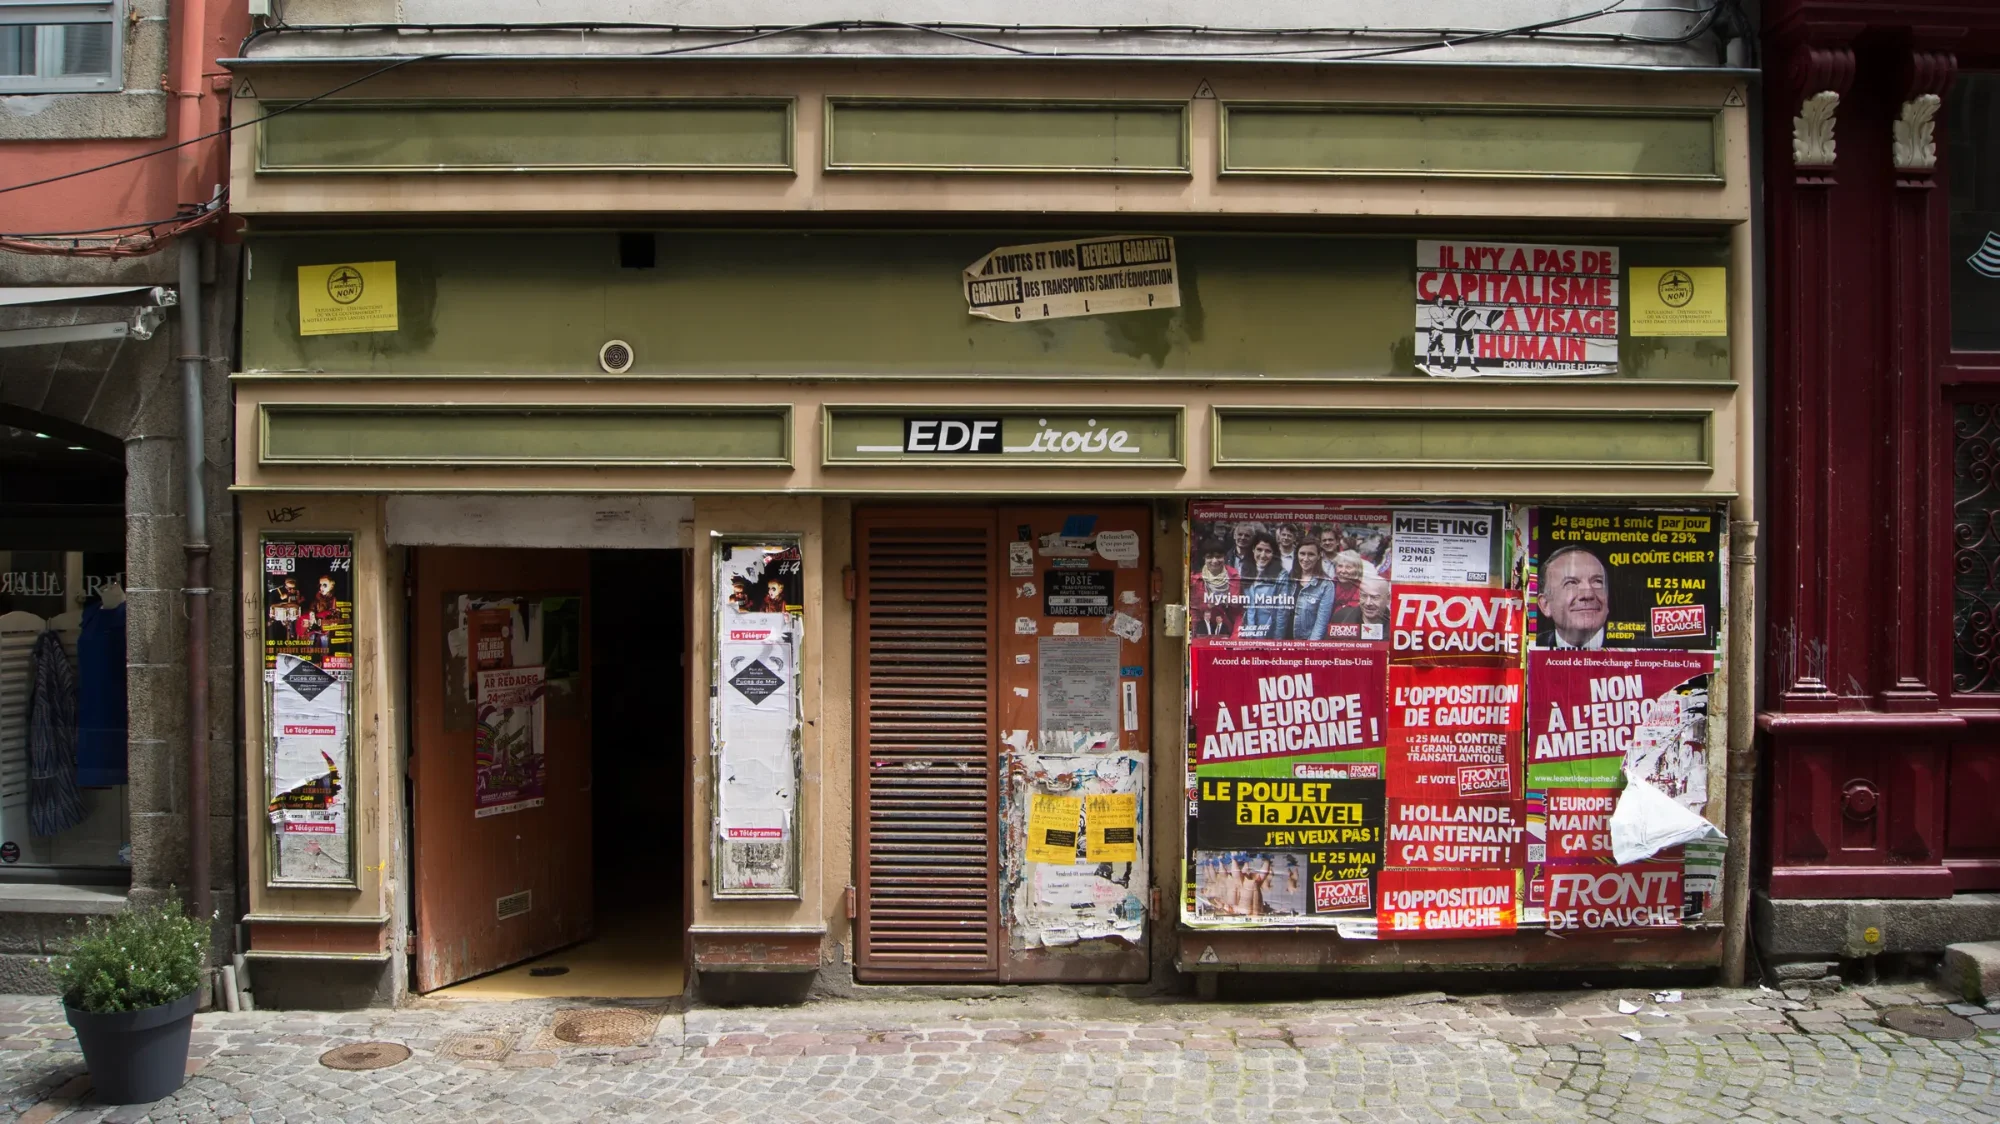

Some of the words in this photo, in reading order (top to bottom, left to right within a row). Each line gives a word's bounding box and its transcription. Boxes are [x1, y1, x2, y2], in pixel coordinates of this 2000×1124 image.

[995, 252, 1033, 274] TOUTES
[1036, 252, 1048, 270] ET
[1050, 248, 1075, 269] TOUS
[1082, 241, 1122, 268] REVENU
[1123, 237, 1169, 263] GARANTI
[1439, 245, 1459, 269] IL
[1464, 246, 1505, 270] N'Y
[1509, 248, 1529, 271] A
[1533, 248, 1576, 273] PAS
[1581, 251, 1612, 274] DE
[1024, 280, 1041, 298] DES
[1418, 272, 1612, 306] CAPITALISME
[1499, 307, 1520, 332] A
[1523, 307, 1616, 335] VISAGE
[1478, 333, 1586, 362] HUMAIN
[1503, 361, 1530, 370] POUR
[1530, 361, 1546, 370] UN
[1547, 362, 1576, 371] AUTRE
[907, 420, 998, 451] EDF
[1025, 418, 1136, 453] iroise
[1200, 512, 1229, 520] ROMPRE
[1249, 512, 1293, 520] L'AUSTÉRITÉ
[1354, 514, 1388, 522] L'EUROPE
[1552, 515, 1568, 527] Je
[1570, 516, 1610, 531] gagne
[1613, 516, 1620, 528] 1
[1624, 516, 1654, 529] smic
[1661, 519, 1680, 532] par
[1682, 518, 1707, 532] jour
[1395, 517, 1489, 536] MEETING
[1552, 529, 1566, 541] et
[1568, 530, 1649, 544] m'augmente
[1651, 531, 1668, 543] de
[1670, 533, 1697, 544] 29%
[265, 544, 297, 558] COZ
[1398, 546, 1436, 555] RENNES
[1609, 552, 1630, 567] QUI
[1632, 549, 1670, 564] COÛTE
[1672, 551, 1705, 563] CHER
[329, 558, 351, 573] #4
[1401, 554, 1413, 563] 22
[1414, 555, 1432, 563] MAI
[778, 561, 801, 575] #4
[1408, 566, 1424, 574] 20H
[1064, 575, 1093, 585] POSTE
[1647, 577, 1661, 589] LE
[1664, 578, 1679, 589] 25
[1681, 578, 1706, 590] MAI
[1203, 593, 1251, 606] Myriam
[1254, 593, 1295, 605] Martin
[1655, 590, 1695, 606] Votez
[1050, 605, 1079, 615] DANGER
[1395, 593, 1524, 632] FRONT
[1653, 607, 1702, 624] FRONT
[1329, 625, 1358, 633] FRONT
[1617, 622, 1646, 631] Gattaz
[1654, 624, 1666, 633] DE
[1666, 621, 1702, 632] GAUCHE
[731, 631, 741, 639] Le
[1393, 630, 1425, 651] DE
[1428, 631, 1519, 654] GAUCHE
[1606, 631, 1635, 640] (MEDEF)
[1309, 641, 1355, 649] CIRCONSCRIPTION
[1212, 657, 1240, 666] Accord
[1240, 657, 1251, 666] de
[1251, 657, 1303, 668] libre-échange
[1304, 657, 1373, 668] Europe-Etats-Unis
[1545, 658, 1572, 667] Accord
[1572, 658, 1582, 667] de
[1583, 658, 1633, 669] libre-échange
[1634, 659, 1701, 670] Europe-Etats-Unis
[484, 679, 495, 689] AR
[498, 674, 539, 687] REDADEG
[1258, 672, 1314, 703] NON
[1589, 674, 1644, 703] NON
[1394, 684, 1519, 707] L'OPPOSITION
[1215, 701, 1236, 733] À
[1240, 693, 1363, 731] L'EUROPE
[1404, 707, 1430, 727] DE
[1434, 705, 1510, 727] GAUCHE
[1548, 702, 1567, 733] À
[294, 726, 335, 735] Télégramme
[1202, 719, 1363, 760] AMERICAINE
[1415, 734, 1428, 743] 25
[1454, 732, 1507, 745] CONTRE
[1534, 725, 1641, 760] AMERIC
[1410, 745, 1420, 753] LE
[1421, 744, 1457, 754] GRAND
[1459, 743, 1502, 754] MARCHÉ
[1406, 752, 1505, 764] TRANSATLANTIQUE
[1350, 765, 1377, 773] FRONT
[1461, 767, 1508, 782] FRONT
[1415, 775, 1427, 784] JE
[1429, 775, 1456, 784] VOTE
[1461, 783, 1472, 791] DE
[1473, 780, 1508, 789] GAUCHE
[1202, 781, 1231, 801] LE
[1237, 782, 1332, 803] POULET
[1550, 796, 1613, 811] L'EUROPE
[1239, 804, 1253, 823] à
[1259, 805, 1280, 824] la
[1285, 805, 1360, 825] JAVEL
[1400, 804, 1516, 826] HOLLANDE,
[294, 823, 335, 833] Télégramme
[739, 828, 781, 838] Télégramme
[1390, 824, 1525, 844] MAINTENANT
[1264, 831, 1295, 846] J'EN
[1298, 828, 1339, 844] VEUX
[1341, 828, 1371, 843] PAS
[1561, 834, 1589, 854] ÇA
[1309, 852, 1327, 864] LE
[1328, 852, 1345, 864] 25
[1348, 853, 1376, 865] MAI
[1401, 844, 1429, 865] ÇA
[1433, 845, 1502, 863] SUFFIT
[1313, 866, 1333, 882] Je
[1338, 864, 1370, 878] vote
[1317, 882, 1367, 898] FRONT
[1549, 871, 1679, 908] FRONT
[1317, 898, 1331, 907] DE
[1331, 894, 1367, 906] GAUCHE
[1383, 885, 1510, 911] L'OPPOSITION
[1394, 911, 1420, 931] DE
[1424, 907, 1501, 930] GAUCHE
[1550, 910, 1580, 930] DE
[1582, 905, 1676, 929] GAUCHE
